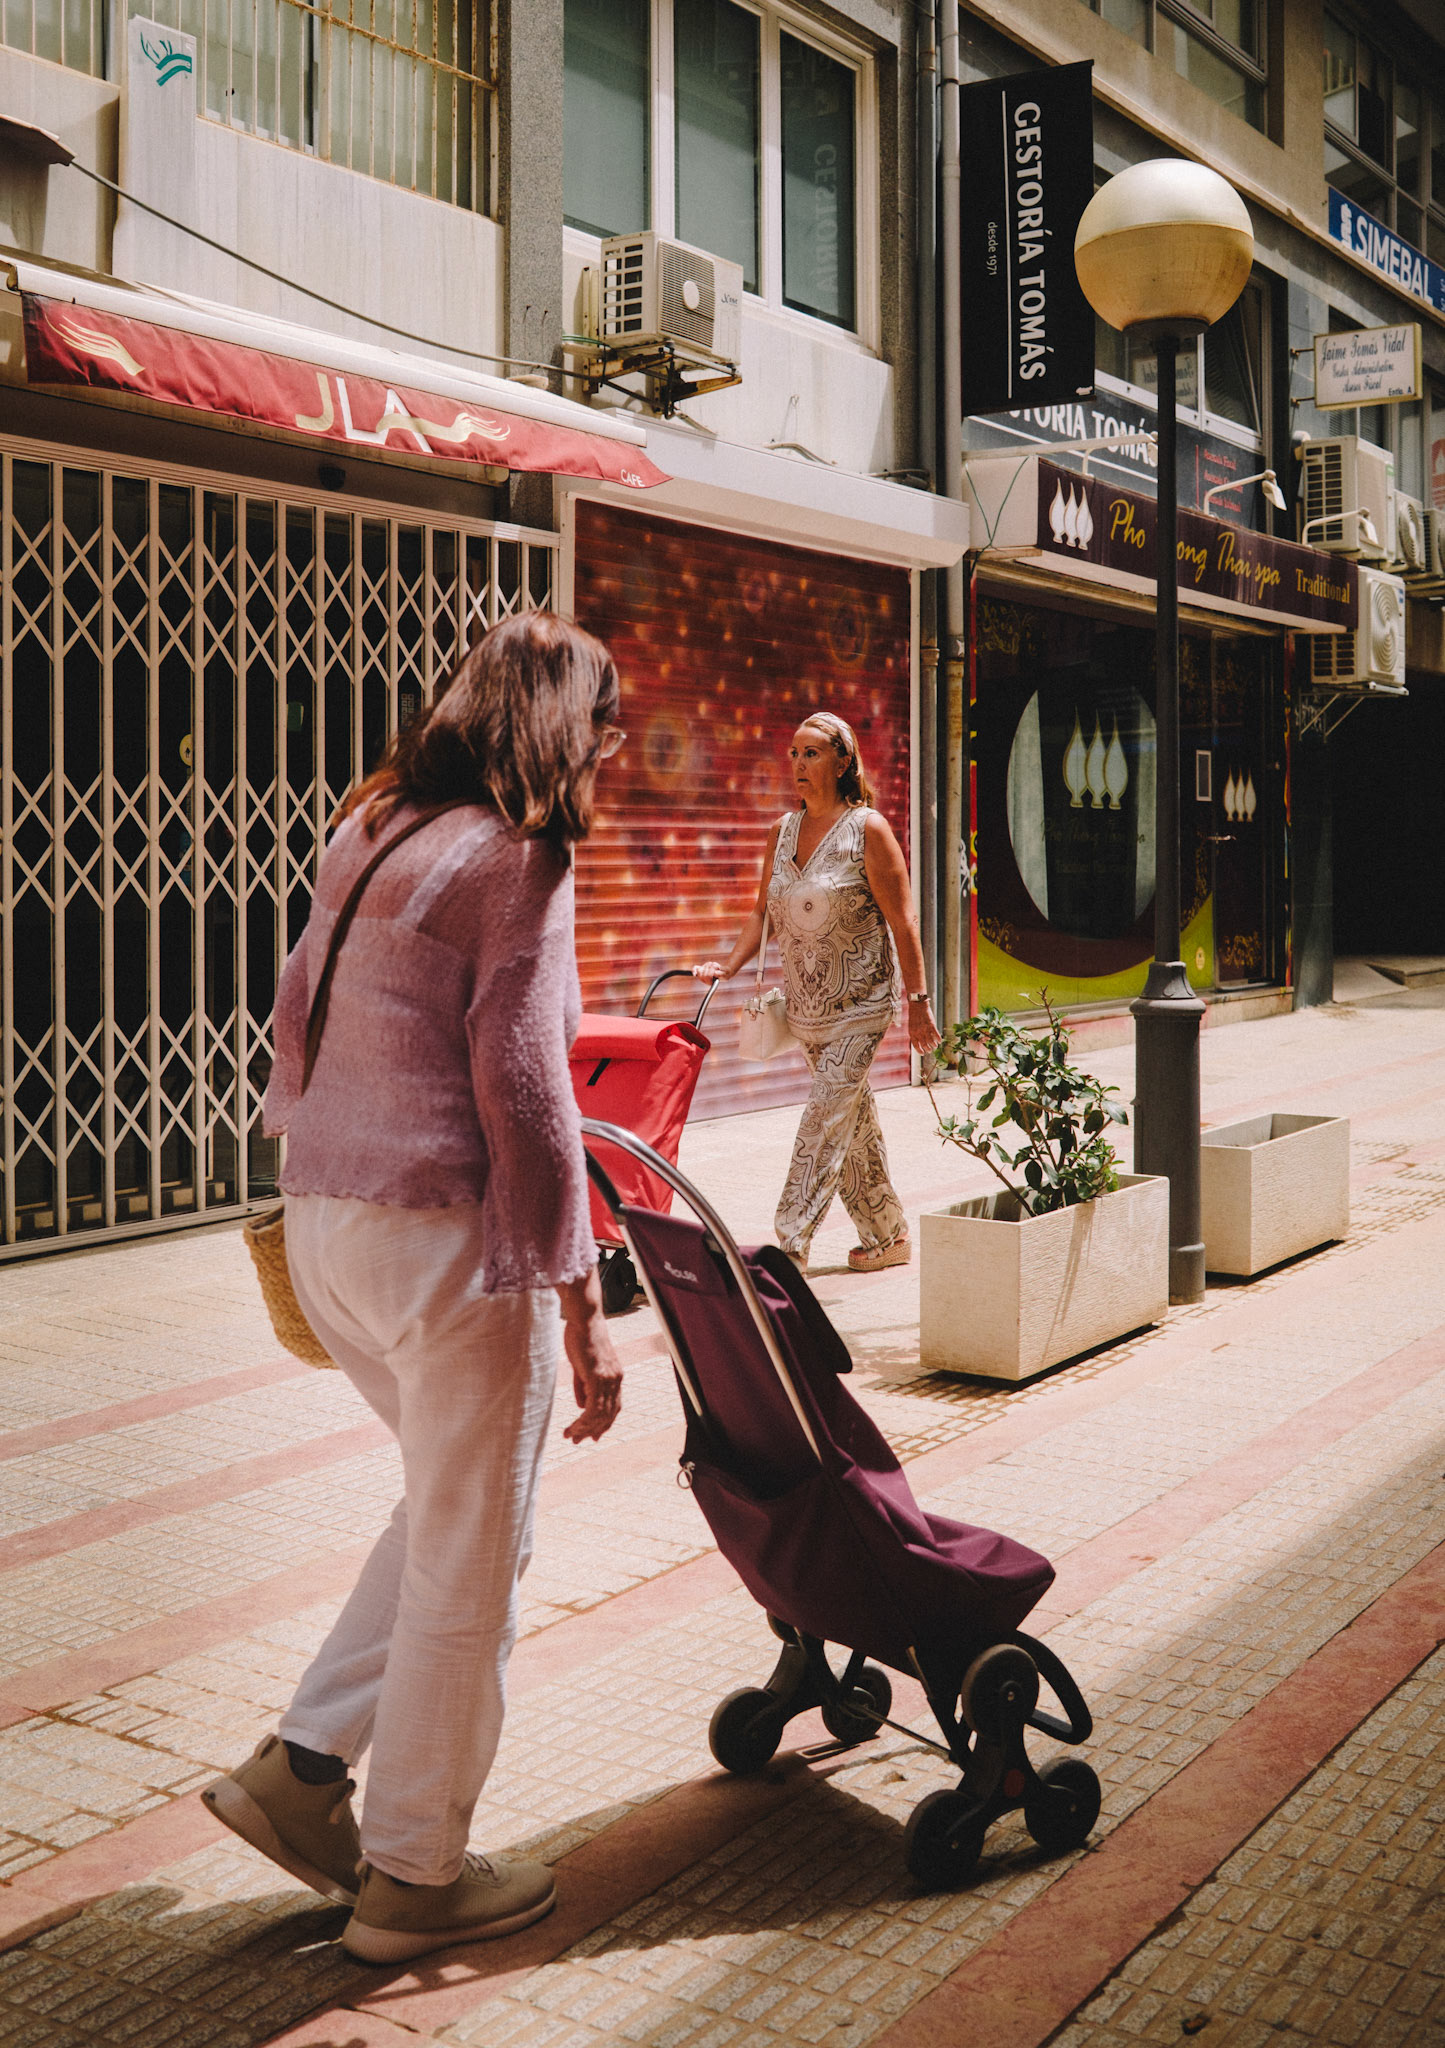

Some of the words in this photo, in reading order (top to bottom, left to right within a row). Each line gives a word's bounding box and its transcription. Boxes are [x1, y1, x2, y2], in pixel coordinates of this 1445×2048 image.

[1014, 102, 1052, 264] GESTORÍA
[986, 254, 998, 276] 1971
[987, 221, 999, 253] desde
[1355, 215, 1433, 306] SIMEBAL
[1018, 269, 1054, 380] TOMÁS
[1319, 338, 1346, 371] Jaime
[1350, 334, 1378, 359] Tomás
[1383, 329, 1407, 354] Vidal
[295, 372, 433, 453] JLA
[1407, 385, 1412, 394] A
[620, 468, 645, 488] CAFE
[1109, 498, 1146, 549] Pho
[1176, 540, 1208, 583] ong
[1217, 531, 1252, 578] Thai
[1254, 563, 1281, 600] spa
[1296, 567, 1350, 604] Traditional
